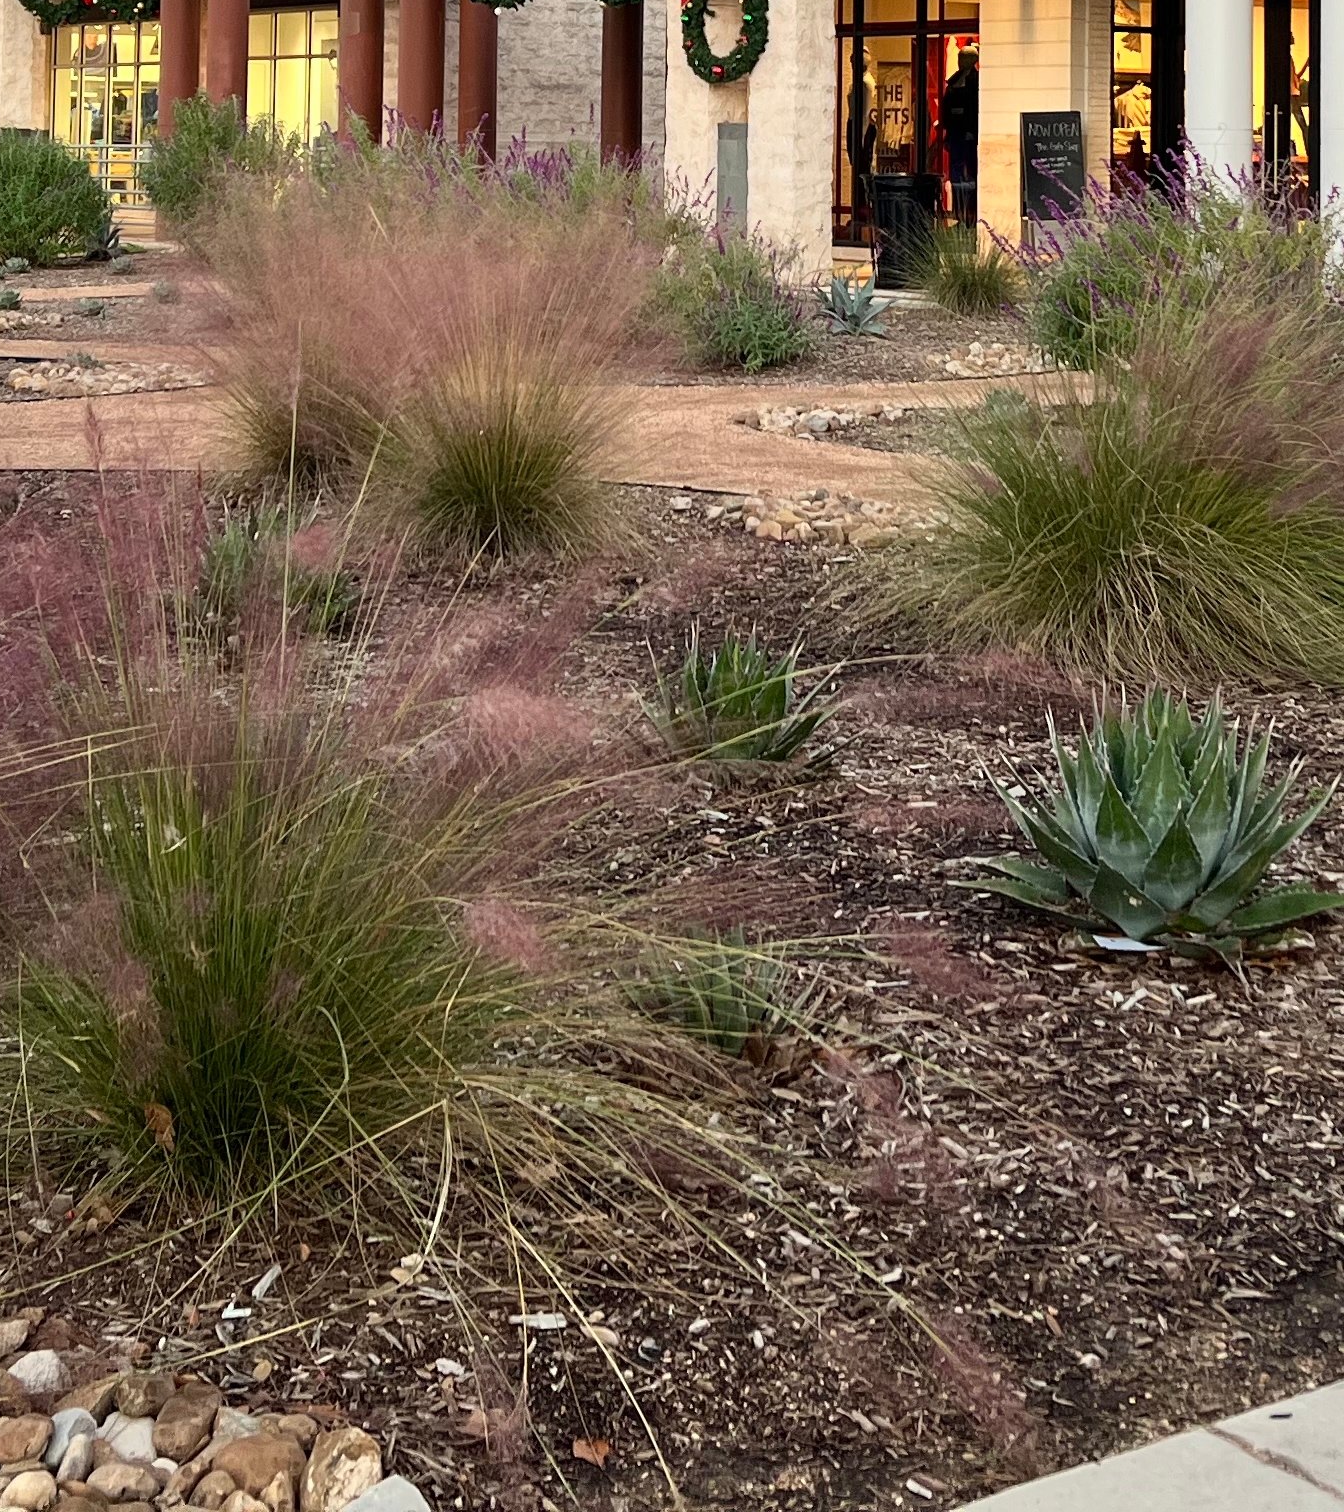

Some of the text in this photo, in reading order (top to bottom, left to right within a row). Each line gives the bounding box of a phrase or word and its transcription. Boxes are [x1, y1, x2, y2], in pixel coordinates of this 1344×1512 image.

[875, 84, 903, 102] THE
[1028, 122, 1080, 138] NOW OPEN
